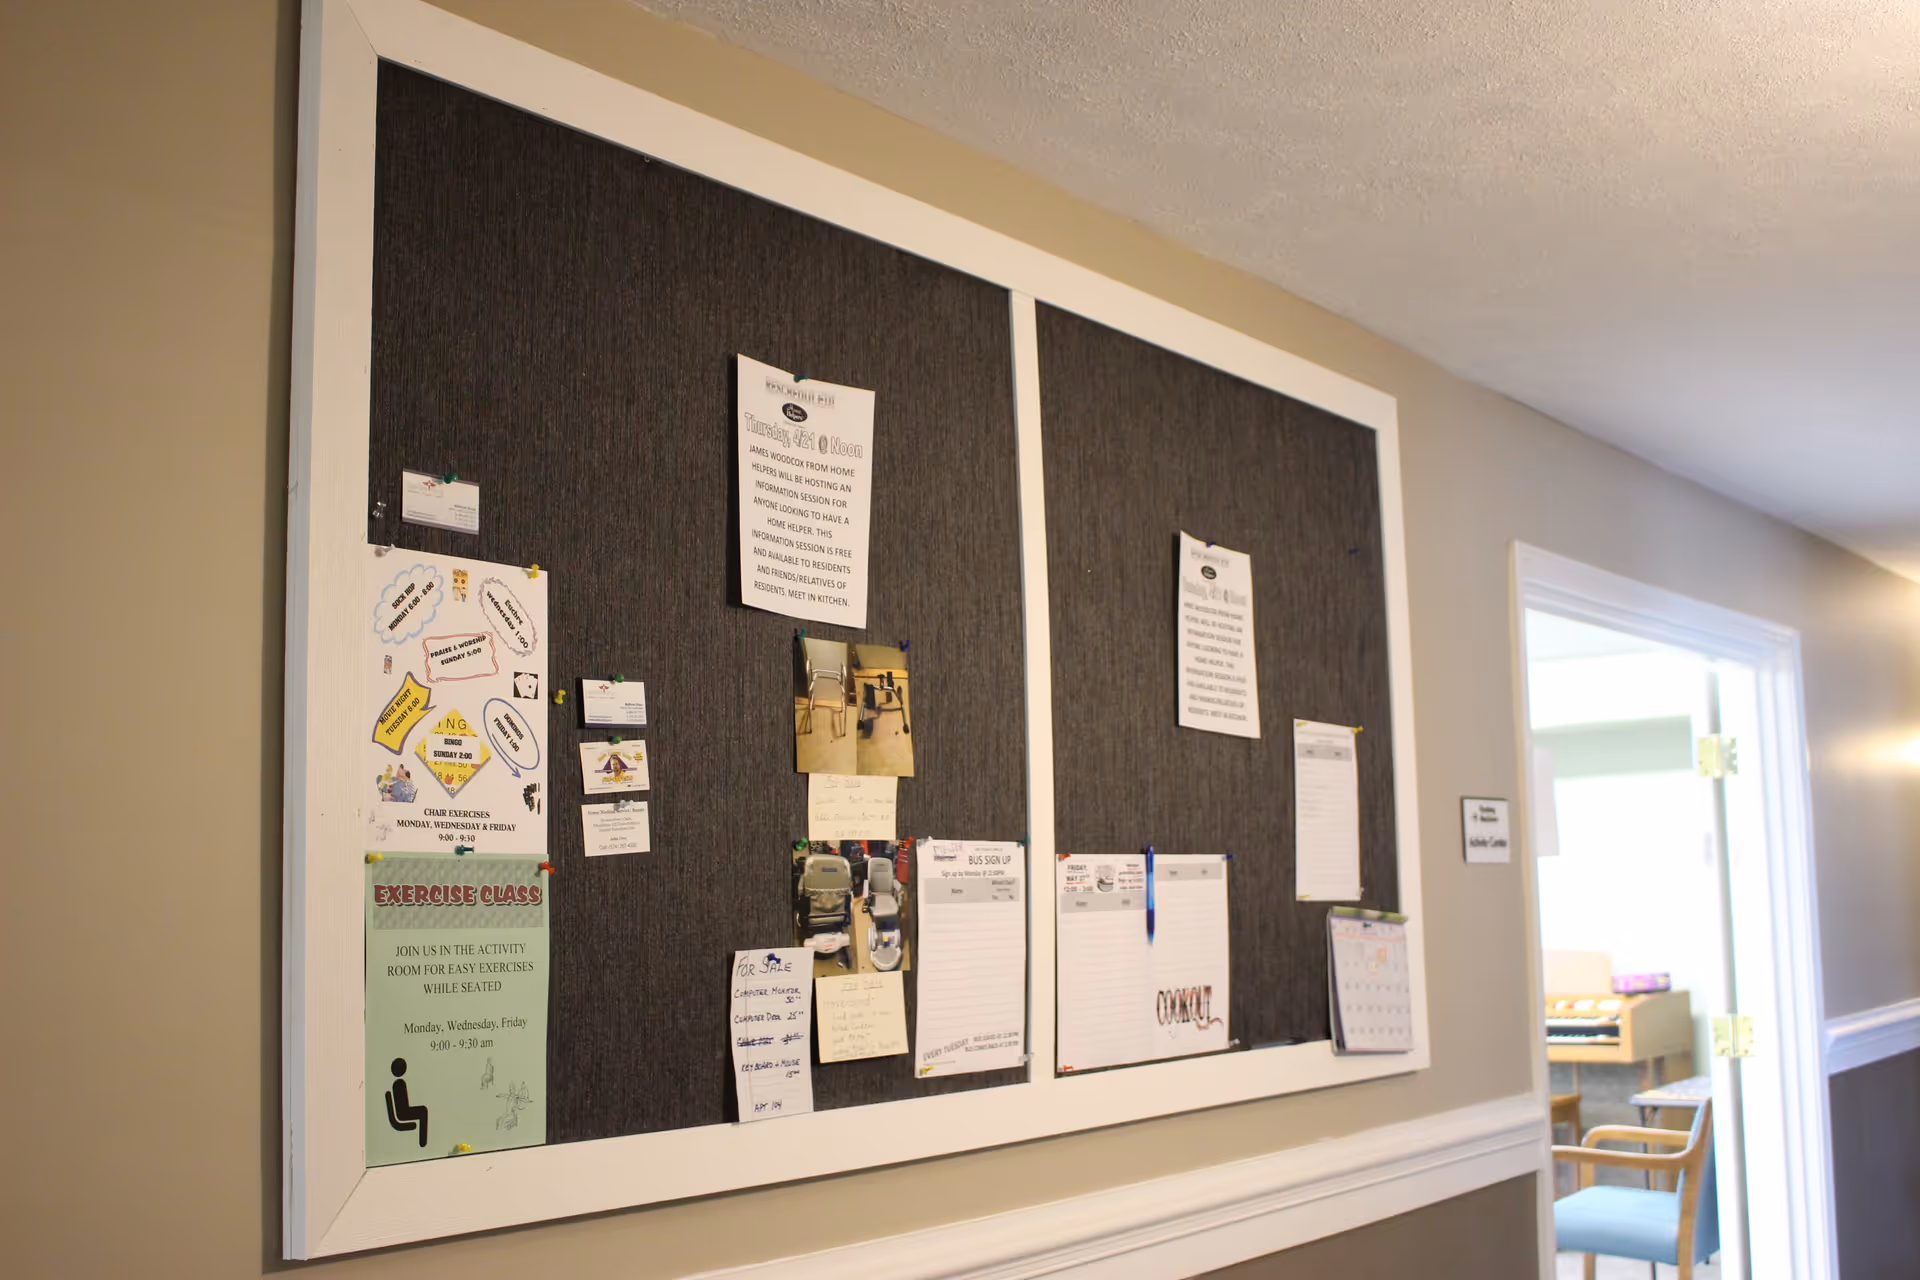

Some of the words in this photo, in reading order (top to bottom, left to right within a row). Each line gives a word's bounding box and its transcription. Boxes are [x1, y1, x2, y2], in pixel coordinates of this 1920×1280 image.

[744, 412, 792, 448] Thursday,
[793, 428, 816, 451] 4/21
[818, 434, 828, 455] @
[830, 434, 863, 459] Noon
[749, 444, 769, 458] JAMES
[770, 450, 804, 469] WOODCOX
[806, 461, 829, 474] FROM
[830, 465, 855, 478] HOME
[752, 462, 777, 478] HELPERS
[778, 470, 793, 482] WILL
[794, 474, 803, 485] BE
[804, 476, 838, 491] HOSTING
[839, 484, 852, 493] AN
[755, 479, 799, 500] INFORMATION
[800, 492, 831, 506] SESSION
[832, 498, 848, 509] FOR
[753, 496, 778, 511] ANYONE
[779, 503, 809, 519] LOOKING
[810, 510, 821, 521] TO
[822, 513, 843, 525] HAVE
[844, 517, 850, 526] A
[767, 516, 786, 530] HOME
[787, 522, 815, 536] HELPER.
[816, 528, 833, 539] THIS
[751, 528, 795, 548] INFORMATION
[795, 540, 825, 554] SESSION
[826, 546, 833, 555] IS
[834, 547, 853, 559] FREE
[753, 546, 767, 558] AND
[768, 550, 799, 566] AVAILABLE
[800, 558, 811, 568] TO
[812, 560, 851, 574] RESIDENTS
[756, 564, 771, 575] AND
[771, 567, 835, 589] FRIENDS/RELATIVES
[836, 580, 847, 590] OF
[388, 607, 410, 632] MONDAY
[407, 596, 421, 610] 6:00
[421, 581, 435, 596] 8:00
[391, 593, 407, 610] SOCK
[404, 582, 416, 596] HOP
[788, 588, 806, 601] MEET
[807, 592, 816, 602] IN
[817, 594, 850, 607] KITCHEN.
[504, 599, 524, 626] Euchre
[430, 646, 453, 659] PRAISE
[458, 635, 487, 649] WORSHIP
[515, 630, 529, 649] 1:00
[440, 652, 466, 666] SUNDAY
[467, 647, 482, 657] 5:00
[379, 705, 397, 726] MOVIE
[395, 688, 412, 708] NIGHT
[385, 709, 409, 736] TUESDAY
[407, 697, 420, 713] 6:00
[493, 717, 512, 740] FRIDAY
[509, 738, 520, 752] 1:00
[503, 712, 525, 740] DOMINOS
[443, 738, 463, 746] BINGO
[433, 750, 458, 759] SUNDAY
[459, 752, 473, 760] 2:00
[423, 808, 447, 817] CHAIR
[448, 809, 490, 819] EXERCISES
[396, 819, 433, 829] MONDAY,
[434, 820, 481, 831] WEDNESDAY
[482, 823, 488, 831] &
[489, 823, 517, 832] FRIDAY
[438, 833, 454, 842] 9:00
[459, 834, 476, 842] 9:30
[968, 855, 984, 865] BUS
[984, 855, 1001, 865] SIGN
[1001, 855, 1011, 865] UP
[941, 870, 951, 878] Sign
[373, 884, 477, 906] EXERCISE
[479, 884, 543, 906] CLASS
[395, 945, 421, 957] JOIN
[422, 945, 438, 957] US
[439, 945, 452, 956] IN
[453, 944, 475, 956] THE
[476, 943, 527, 955] ACTIVITY
[387, 964, 422, 977] ROOM
[424, 964, 446, 976] FOR
[448, 963, 477, 975] EASY
[478, 961, 534, 974] EXERCISES
[736, 956, 756, 977] FOR
[759, 955, 793, 974] SALE
[423, 982, 459, 994] WHILE
[460, 980, 502, 993] SEATED
[734, 988, 769, 999] COMPUTER
[1156, 985, 1212, 1027] COOKOUT
[501, 1017, 528, 1029] Friday
[734, 1014, 765, 1024] COMPUTER
[430, 1040, 451, 1051] 9:00
[458, 1038, 478, 1049] 9:30
[480, 1039, 494, 1048] am
[923, 1048, 943, 1062] EVERY
[943, 1037, 970, 1054] TUESDAY
[780, 1058, 801, 1068] MOUSE
[754, 1102, 769, 1113] APT
